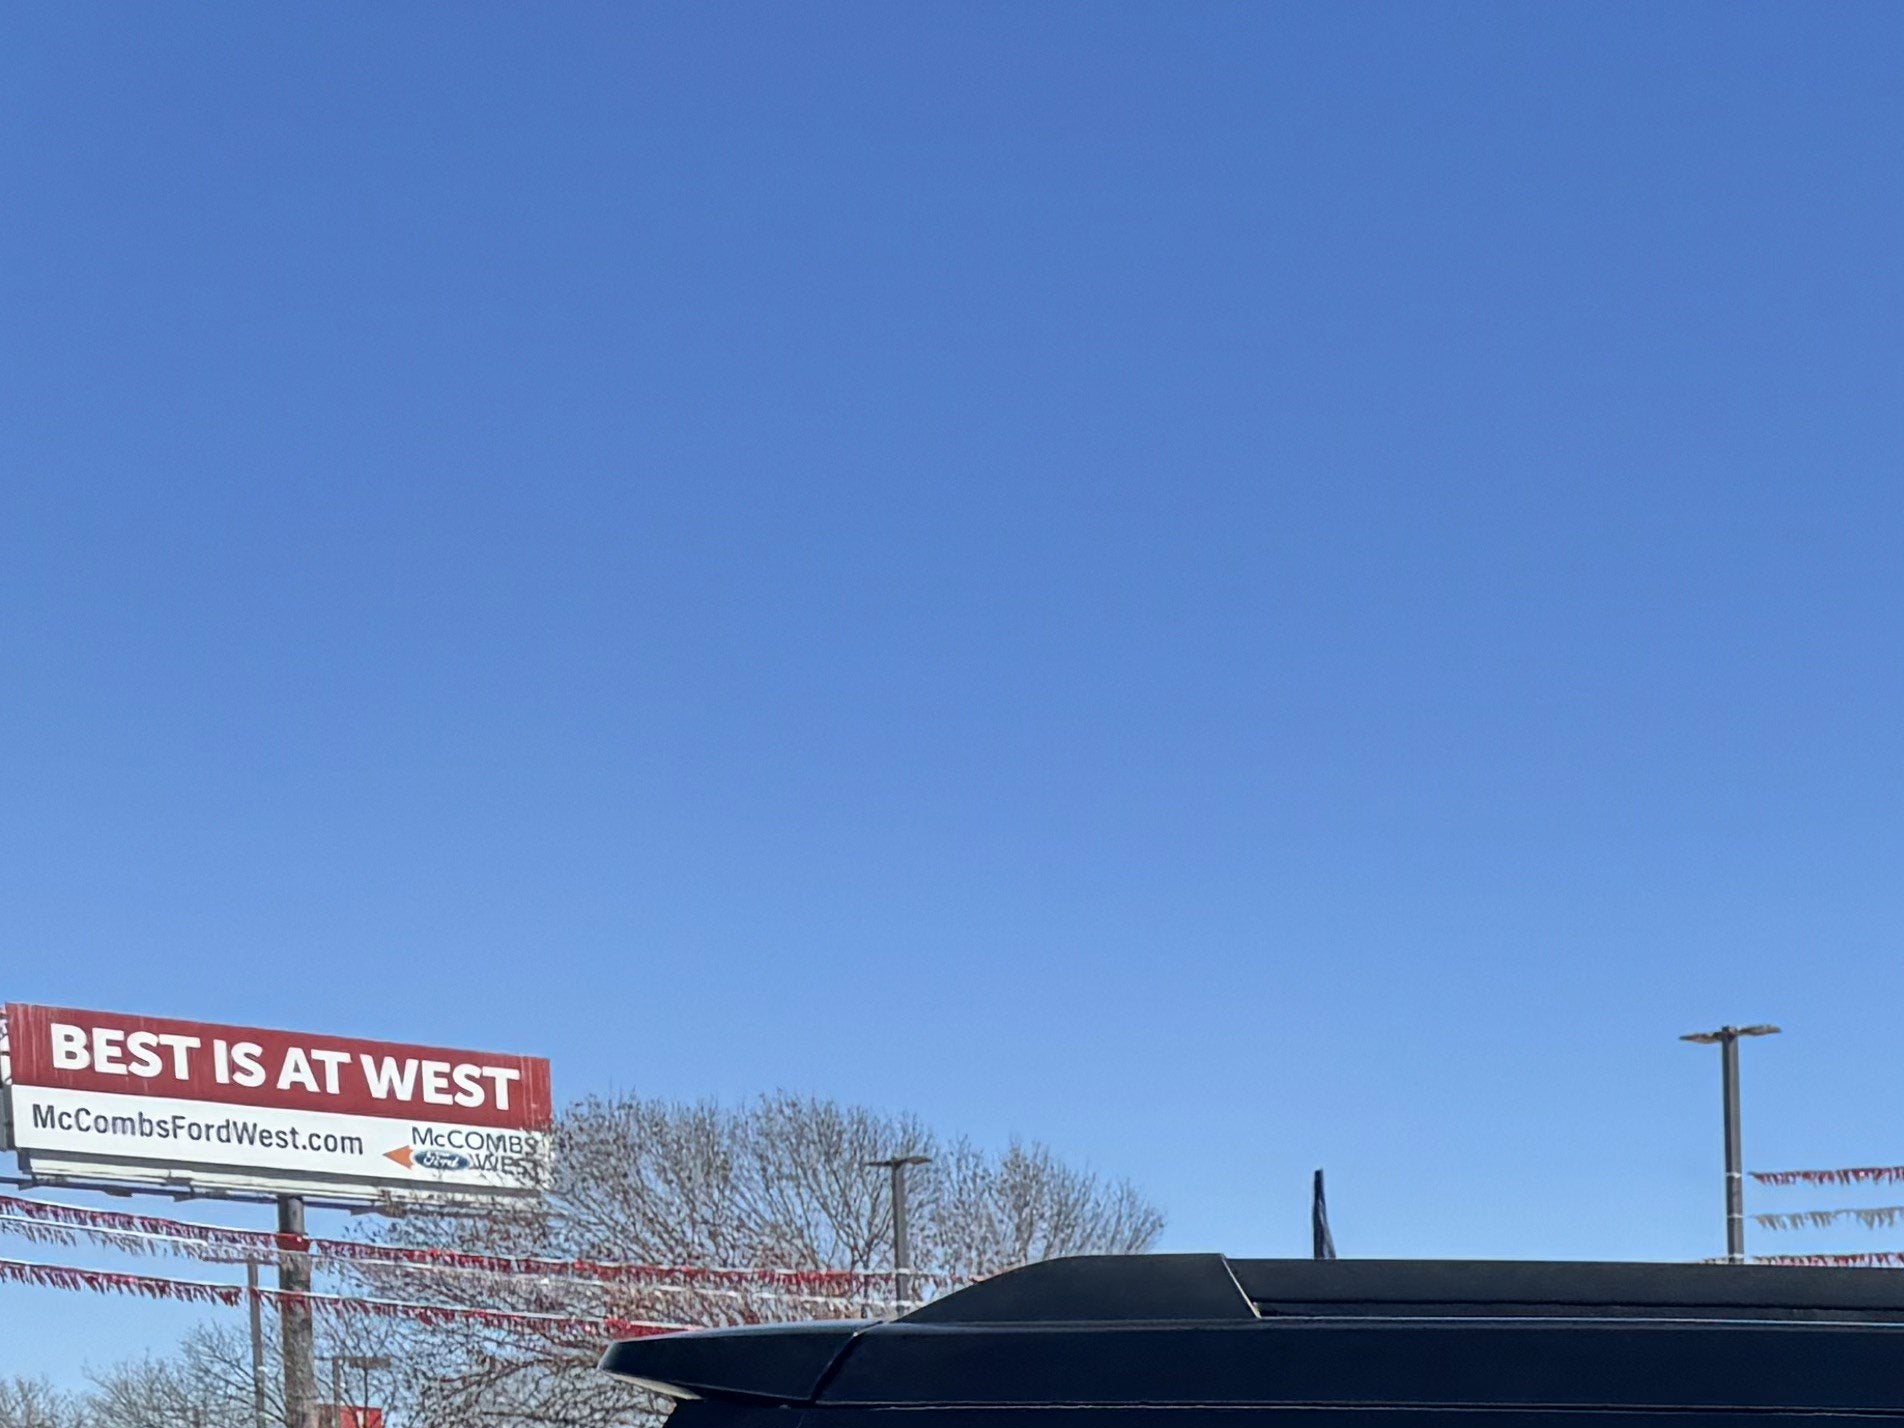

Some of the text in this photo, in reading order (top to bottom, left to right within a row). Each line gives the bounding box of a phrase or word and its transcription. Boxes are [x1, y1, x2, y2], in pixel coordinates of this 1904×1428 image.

[50, 1022, 520, 1112] BEST IS AT WEST
[32, 1103, 364, 1156] McCombsFordWest.com
[411, 1126, 540, 1155] McCOMBS
